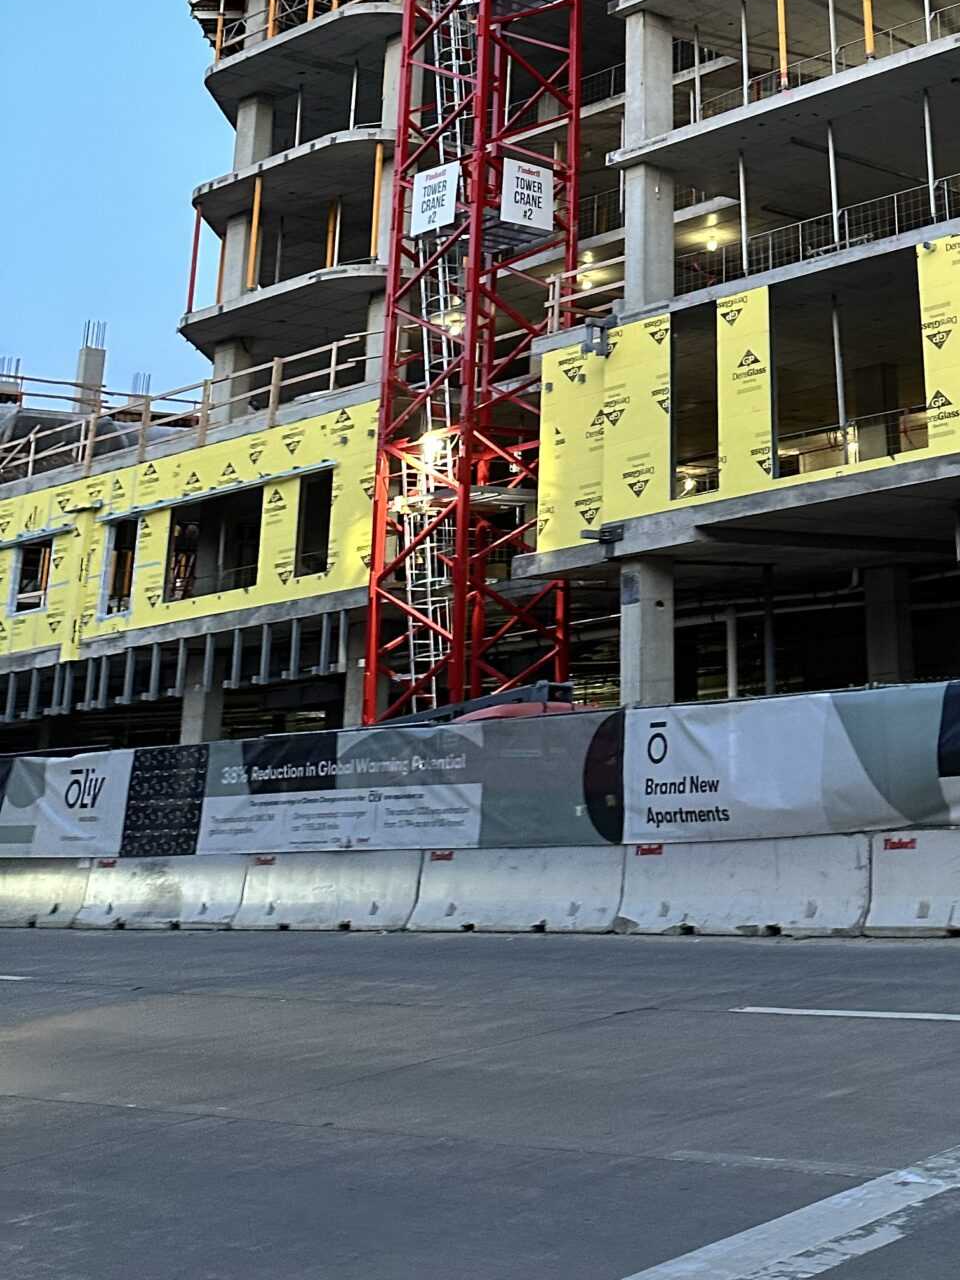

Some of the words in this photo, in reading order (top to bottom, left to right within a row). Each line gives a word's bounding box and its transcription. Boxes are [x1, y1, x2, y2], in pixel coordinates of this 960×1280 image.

[423, 180, 447, 198] TOWER
[516, 176, 543, 194] TOWER
[421, 194, 446, 213] CRANE
[514, 191, 543, 209] CRANE
[523, 208, 533, 220] #2
[932, 332, 946, 343] GP
[742, 355, 755, 365] GP
[931, 396, 946, 408] GP
[927, 409, 960, 423] ensGlass
[251, 763, 304, 781] Reduction
[306, 762, 317, 776] in
[318, 758, 355, 776] Global
[356, 756, 409, 776] Warming
[411, 753, 466, 771] Potential
[645, 776, 687, 796] Brand
[690, 775, 719, 793] New
[647, 806, 730, 828] Apartments
